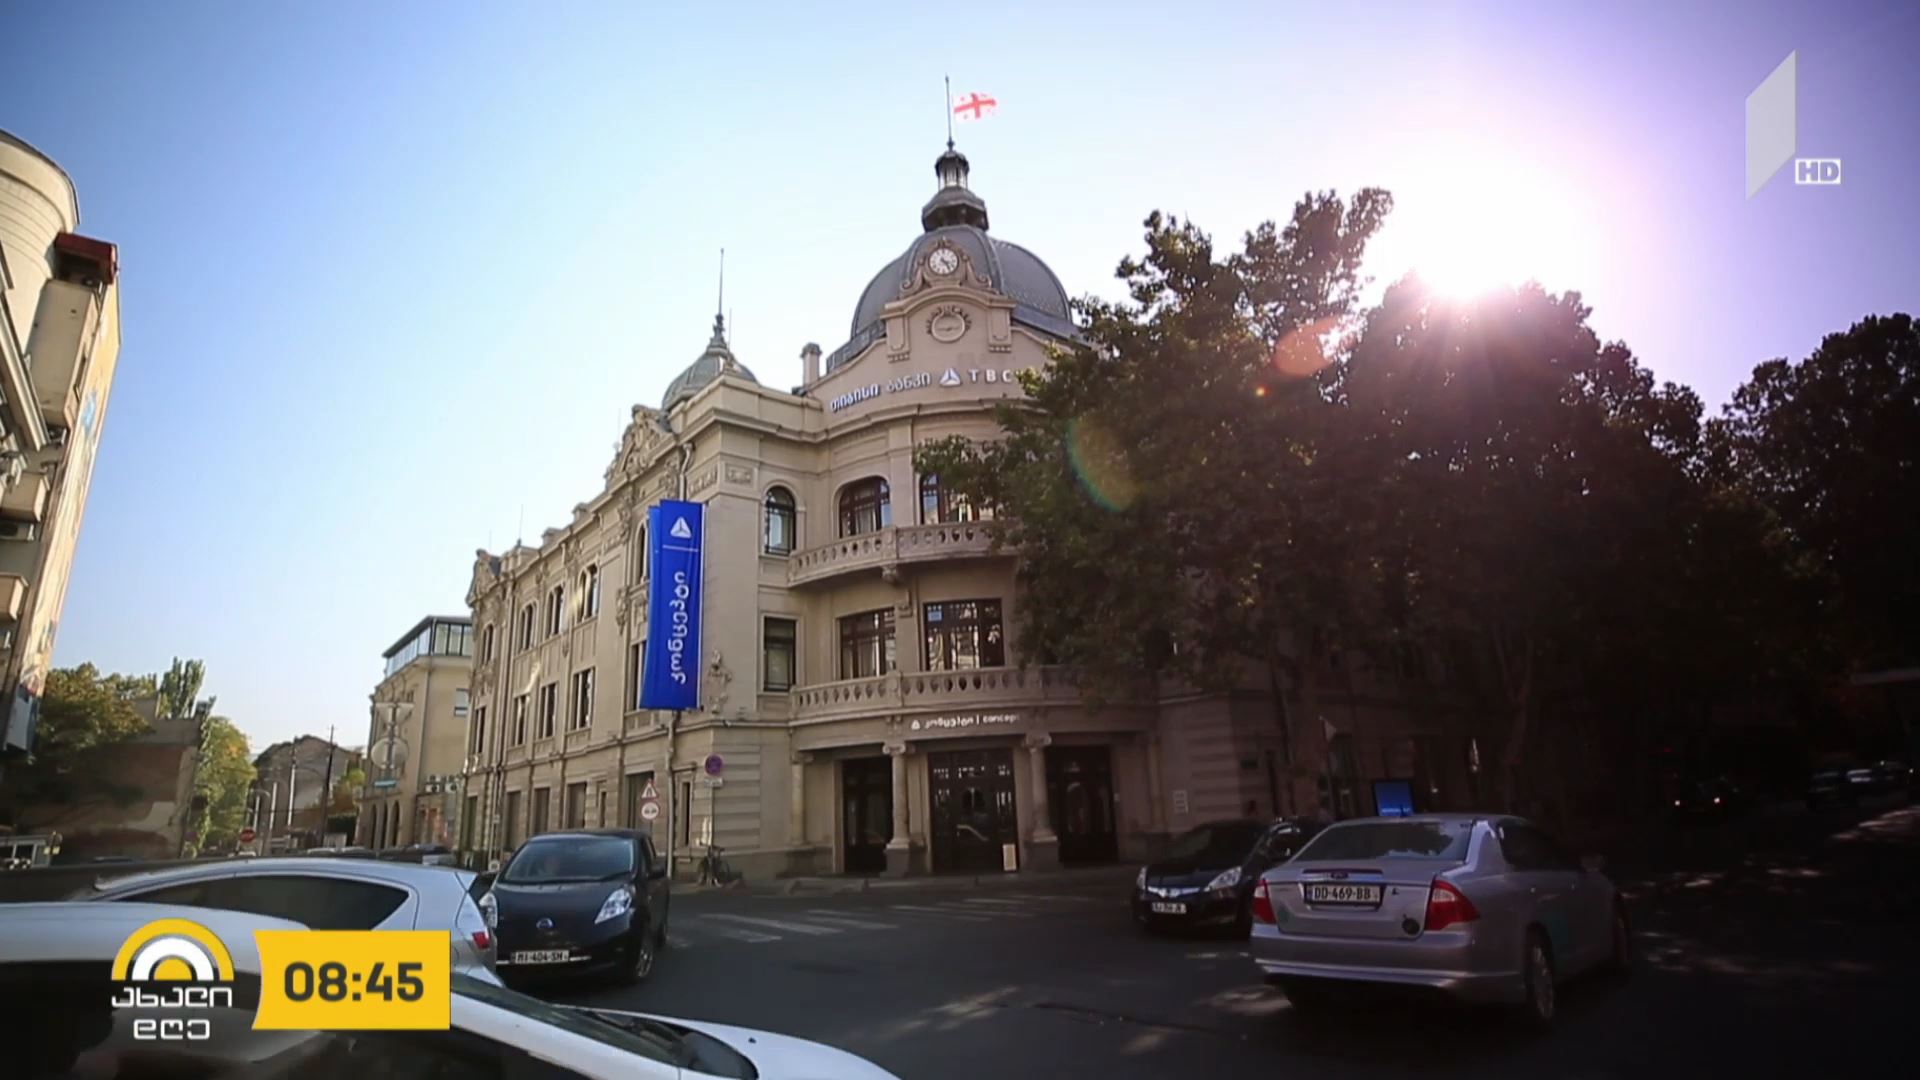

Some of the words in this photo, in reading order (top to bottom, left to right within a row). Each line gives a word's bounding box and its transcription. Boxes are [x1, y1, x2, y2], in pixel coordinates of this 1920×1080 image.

[968, 369, 1012, 382] TBC
[830, 383, 880, 412] თიბისი
[886, 372, 931, 392] ბანკი
[668, 571, 690, 684] კონცეპტი
[1314, 887, 1371, 900] DD-469-BB
